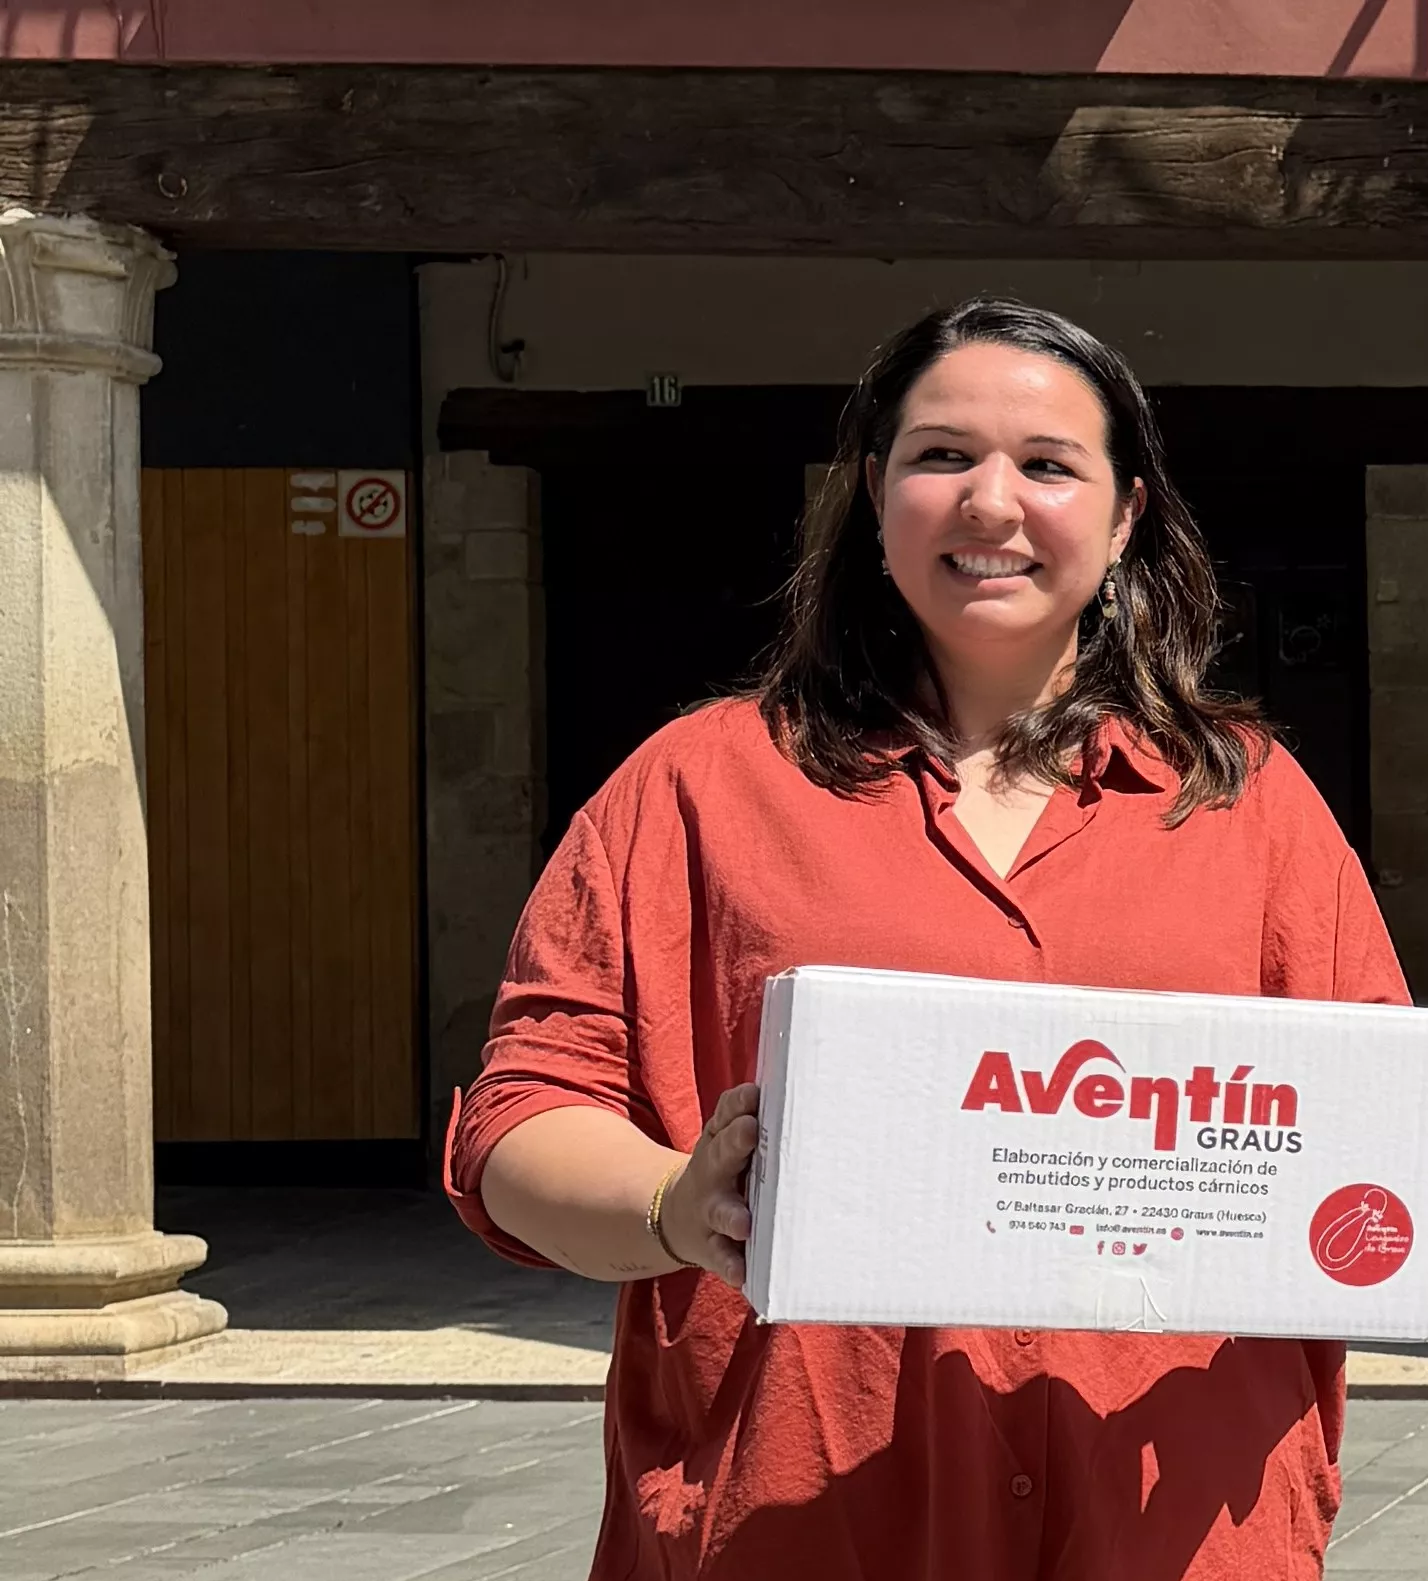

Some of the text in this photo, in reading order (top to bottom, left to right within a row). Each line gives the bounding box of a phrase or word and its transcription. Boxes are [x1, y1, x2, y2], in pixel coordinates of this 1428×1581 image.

[653, 375, 676, 403] 16
[1196, 1127, 1303, 1154] GRAUS
[992, 1148, 1278, 1176] Elaboración y comercialización de
[997, 1170, 1269, 1195] embutidos y productos cárnicos
[1014, 1201, 1061, 1213] Baltasar
[1114, 1205, 1129, 1216] 27
[1141, 1207, 1179, 1219] 22430
[1181, 1208, 1214, 1220] Graus
[1216, 1210, 1267, 1224] (Huesca)
